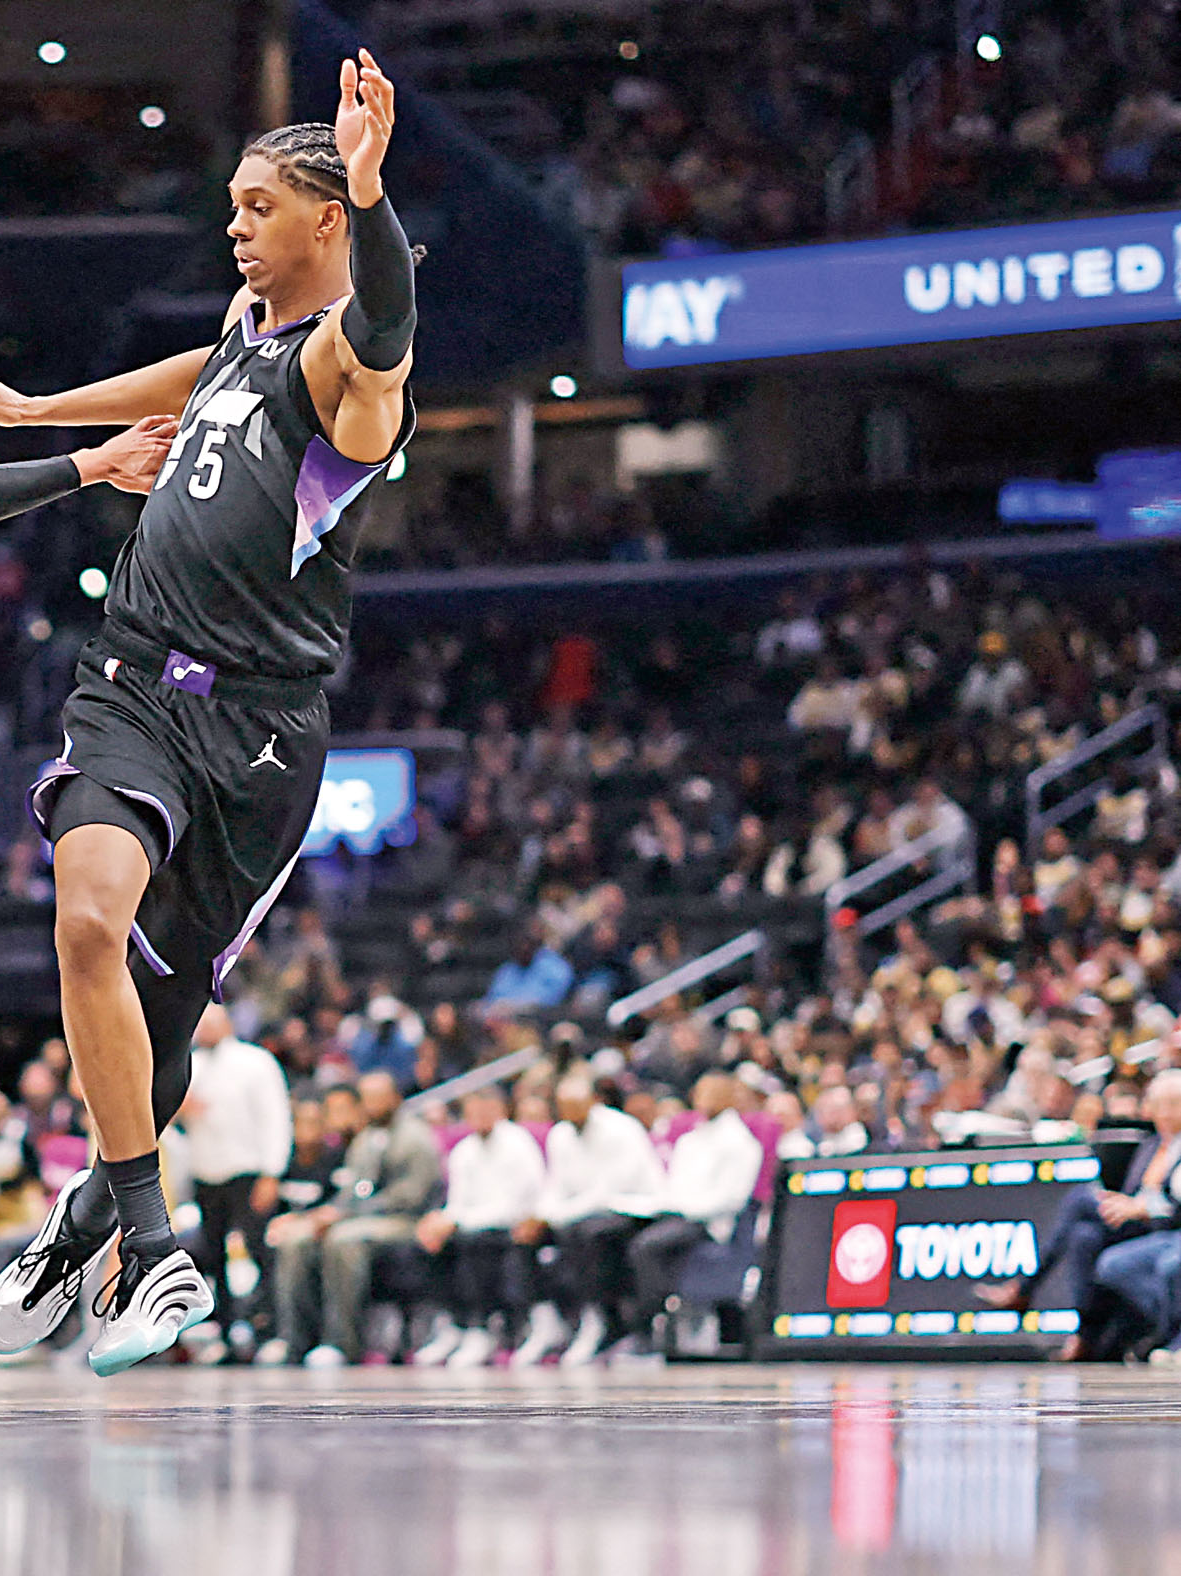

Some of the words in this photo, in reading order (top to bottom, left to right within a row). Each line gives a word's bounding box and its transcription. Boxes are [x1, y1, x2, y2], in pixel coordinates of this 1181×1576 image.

[903, 244, 1165, 313] UNITED
[188, 429, 228, 500] 5
[895, 1220, 1039, 1280] TOYOTA
